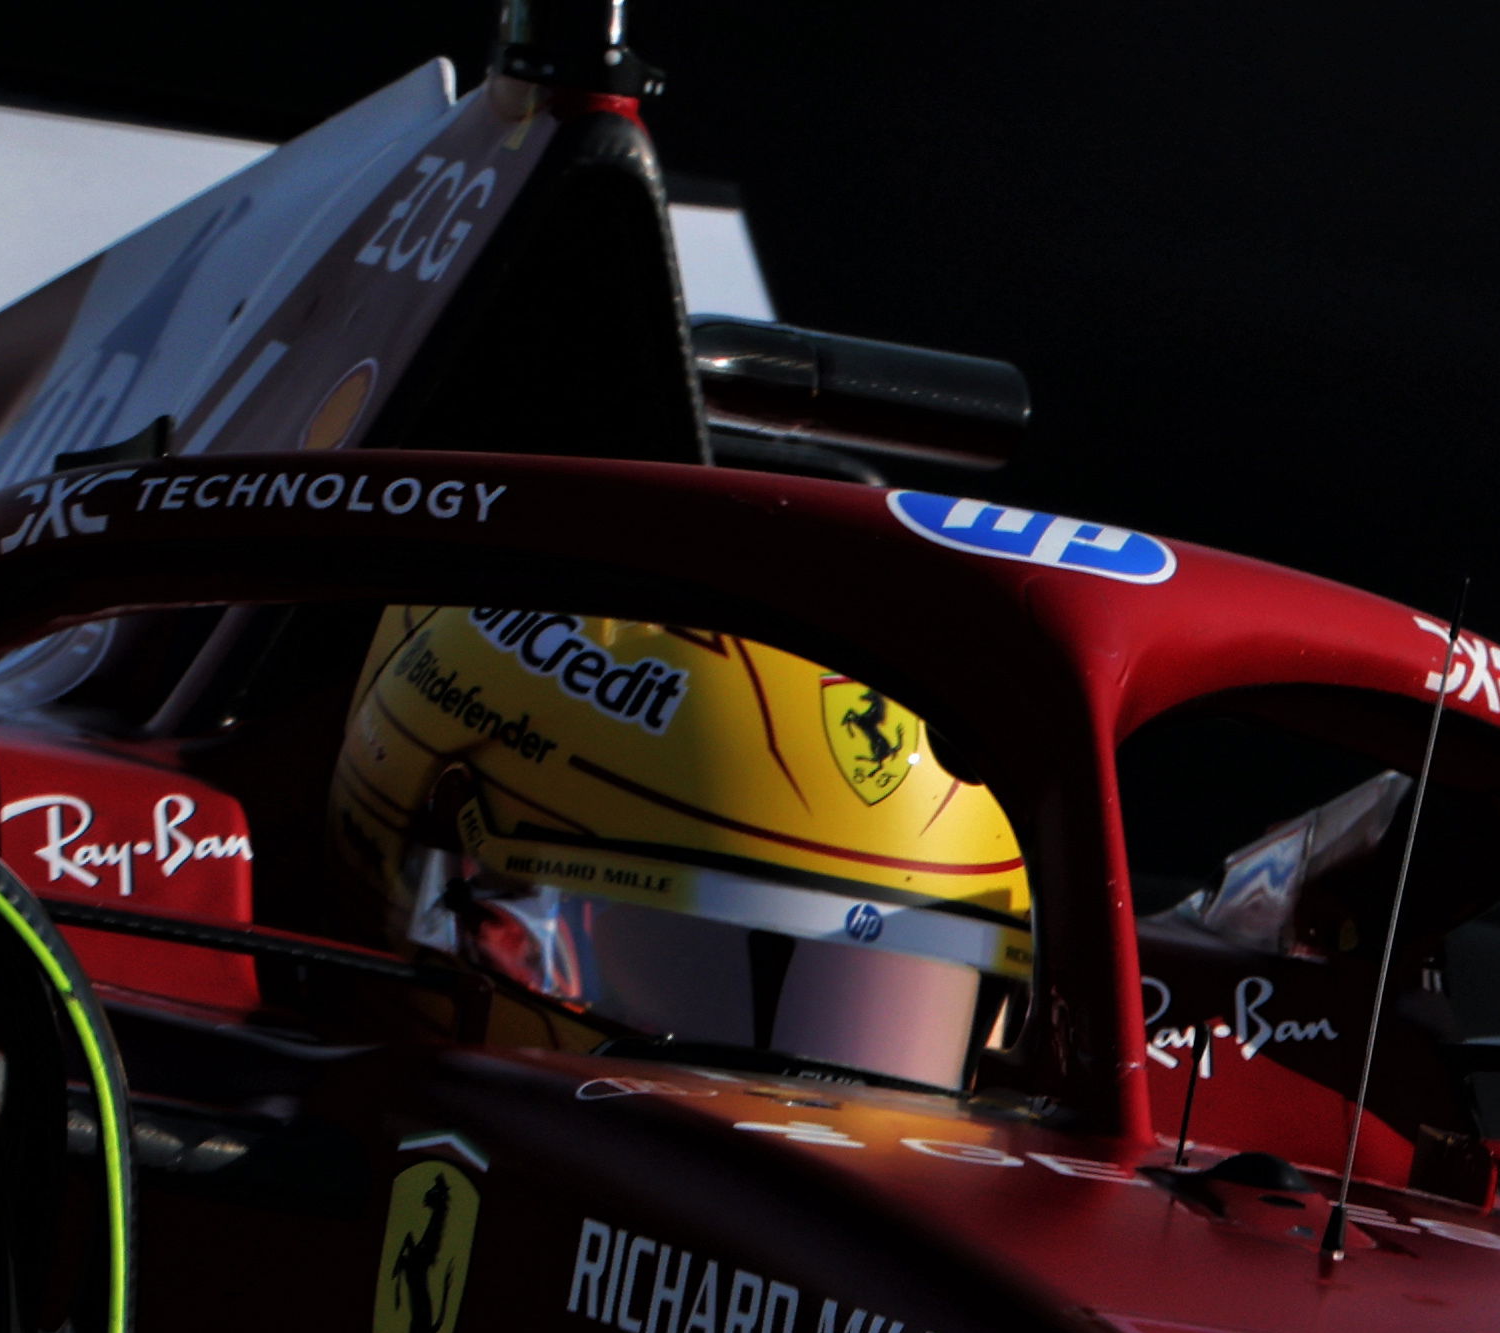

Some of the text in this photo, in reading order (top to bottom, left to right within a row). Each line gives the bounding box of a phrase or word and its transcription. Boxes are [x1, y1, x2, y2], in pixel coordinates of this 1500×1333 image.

[134, 470, 508, 524] TECHNOLOGY
[406, 648, 558, 764] Bitdefender
[505, 855, 675, 893] RICHARD MILLE
[846, 903, 882, 942] hp
